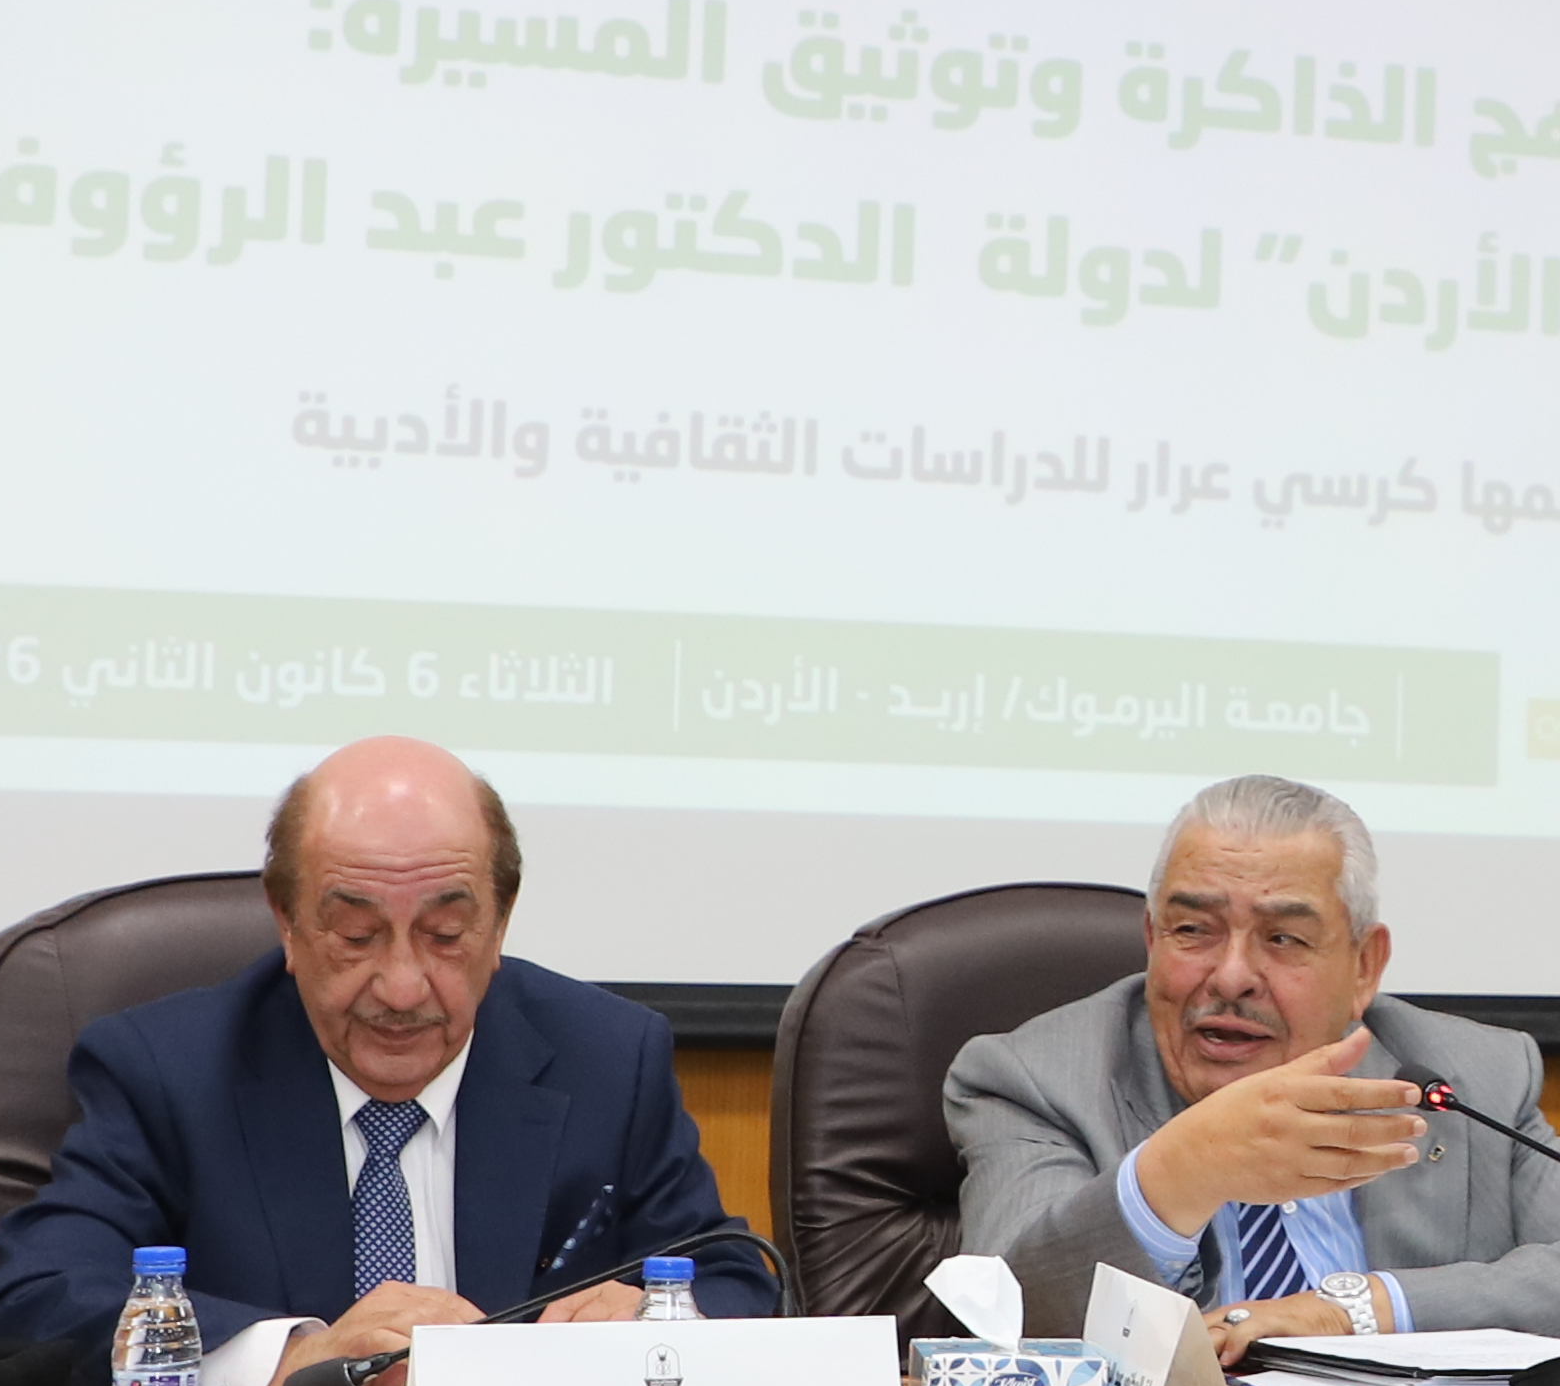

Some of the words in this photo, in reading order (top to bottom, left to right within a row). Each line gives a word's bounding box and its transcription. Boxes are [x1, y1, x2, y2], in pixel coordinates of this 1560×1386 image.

[760, 7, 1084, 141] وتوثيق
[1116, 39, 1438, 151] الذاكرة
[365, 189, 527, 281] عبد
[551, 188, 917, 295] الدكتور
[977, 211, 1224, 328] لدولة
[292, 382, 551, 478] والأدبية
[574, 406, 819, 484] الثقافية
[840, 424, 1111, 506] للدراسات
[1125, 438, 1230, 515] عرار
[1252, 456, 1437, 526] كرسي
[60, 634, 217, 709] الثاني
[234, 644, 389, 710] كانون
[406, 649, 442, 700] 6
[456, 648, 617, 706] الثلاثاء
[700, 653, 840, 726] الأردن
